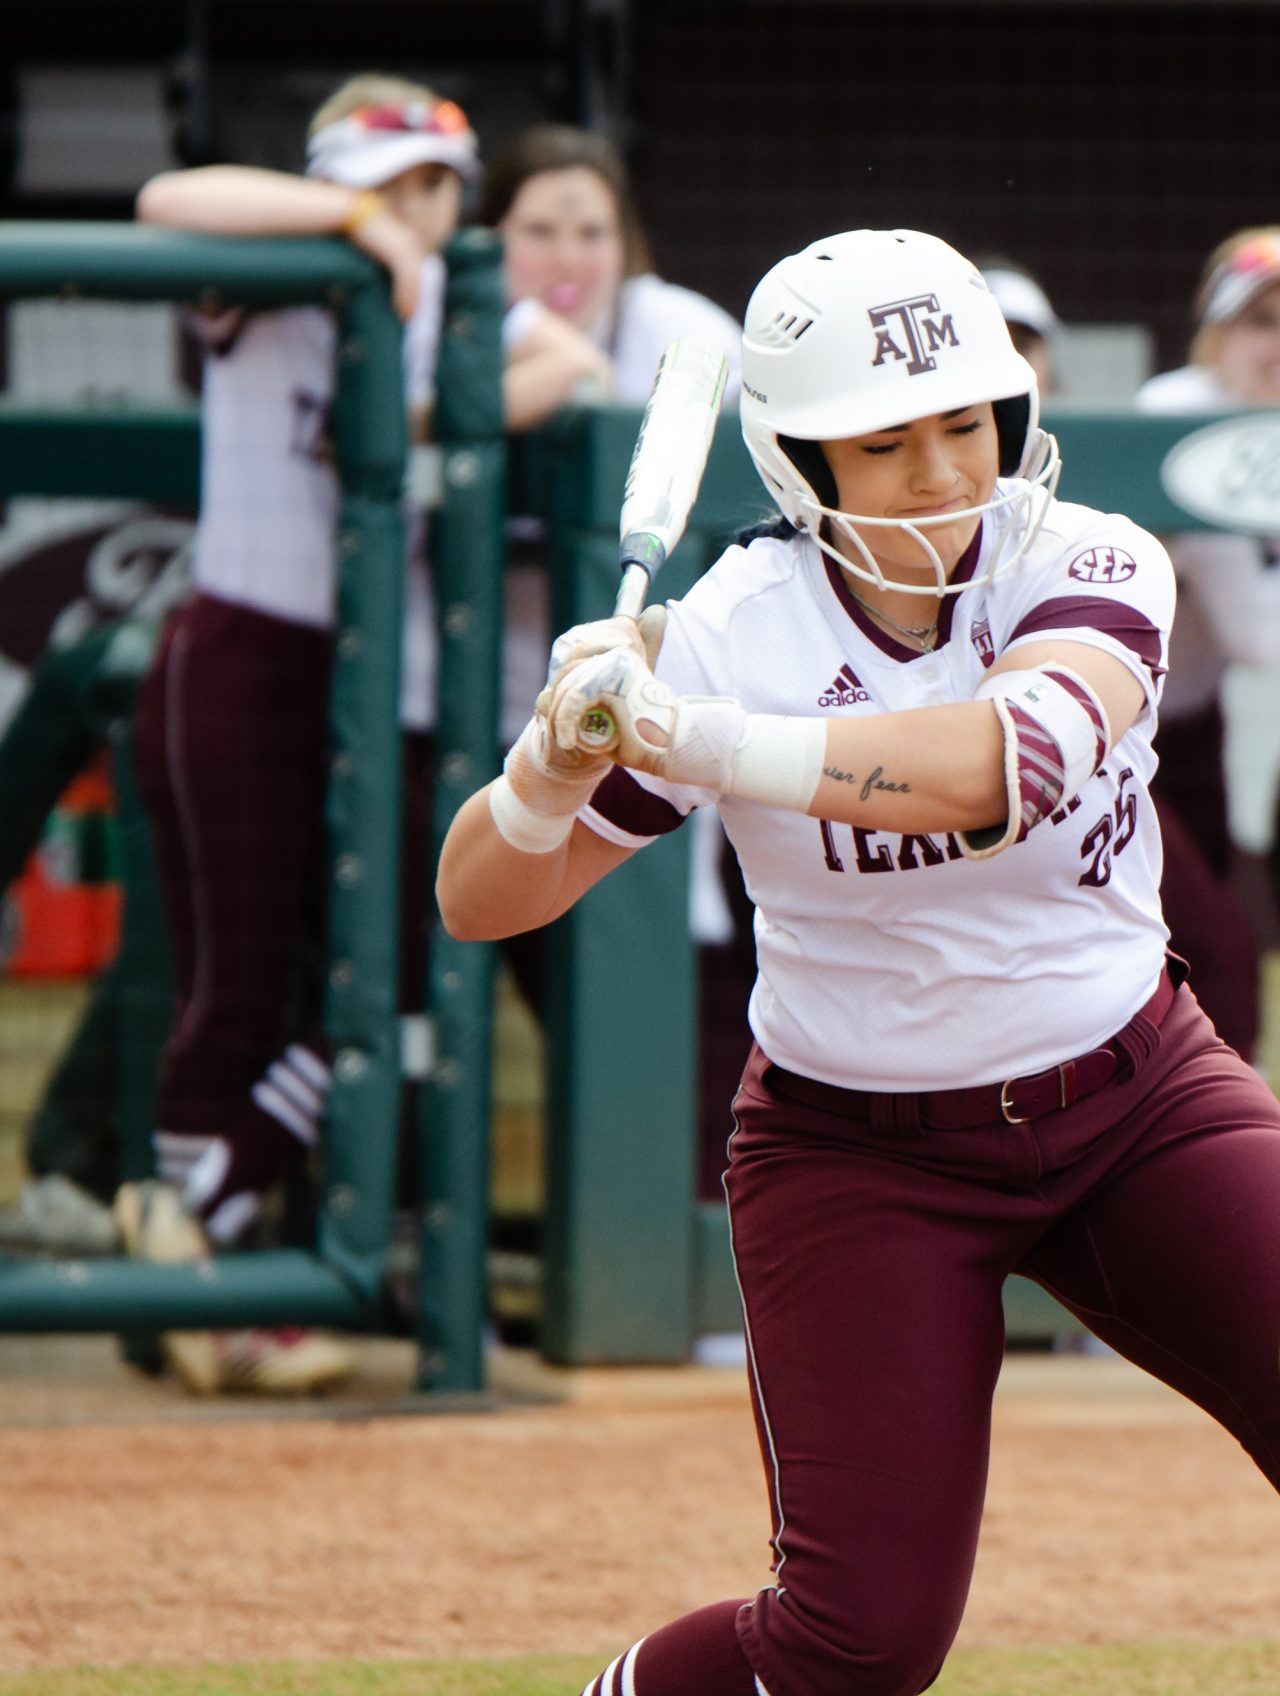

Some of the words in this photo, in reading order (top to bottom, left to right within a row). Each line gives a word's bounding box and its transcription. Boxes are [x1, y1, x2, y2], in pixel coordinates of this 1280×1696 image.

[1069, 547, 1137, 583] SEC
[859, 765, 912, 801] fear
[1078, 766, 1138, 888] 25
